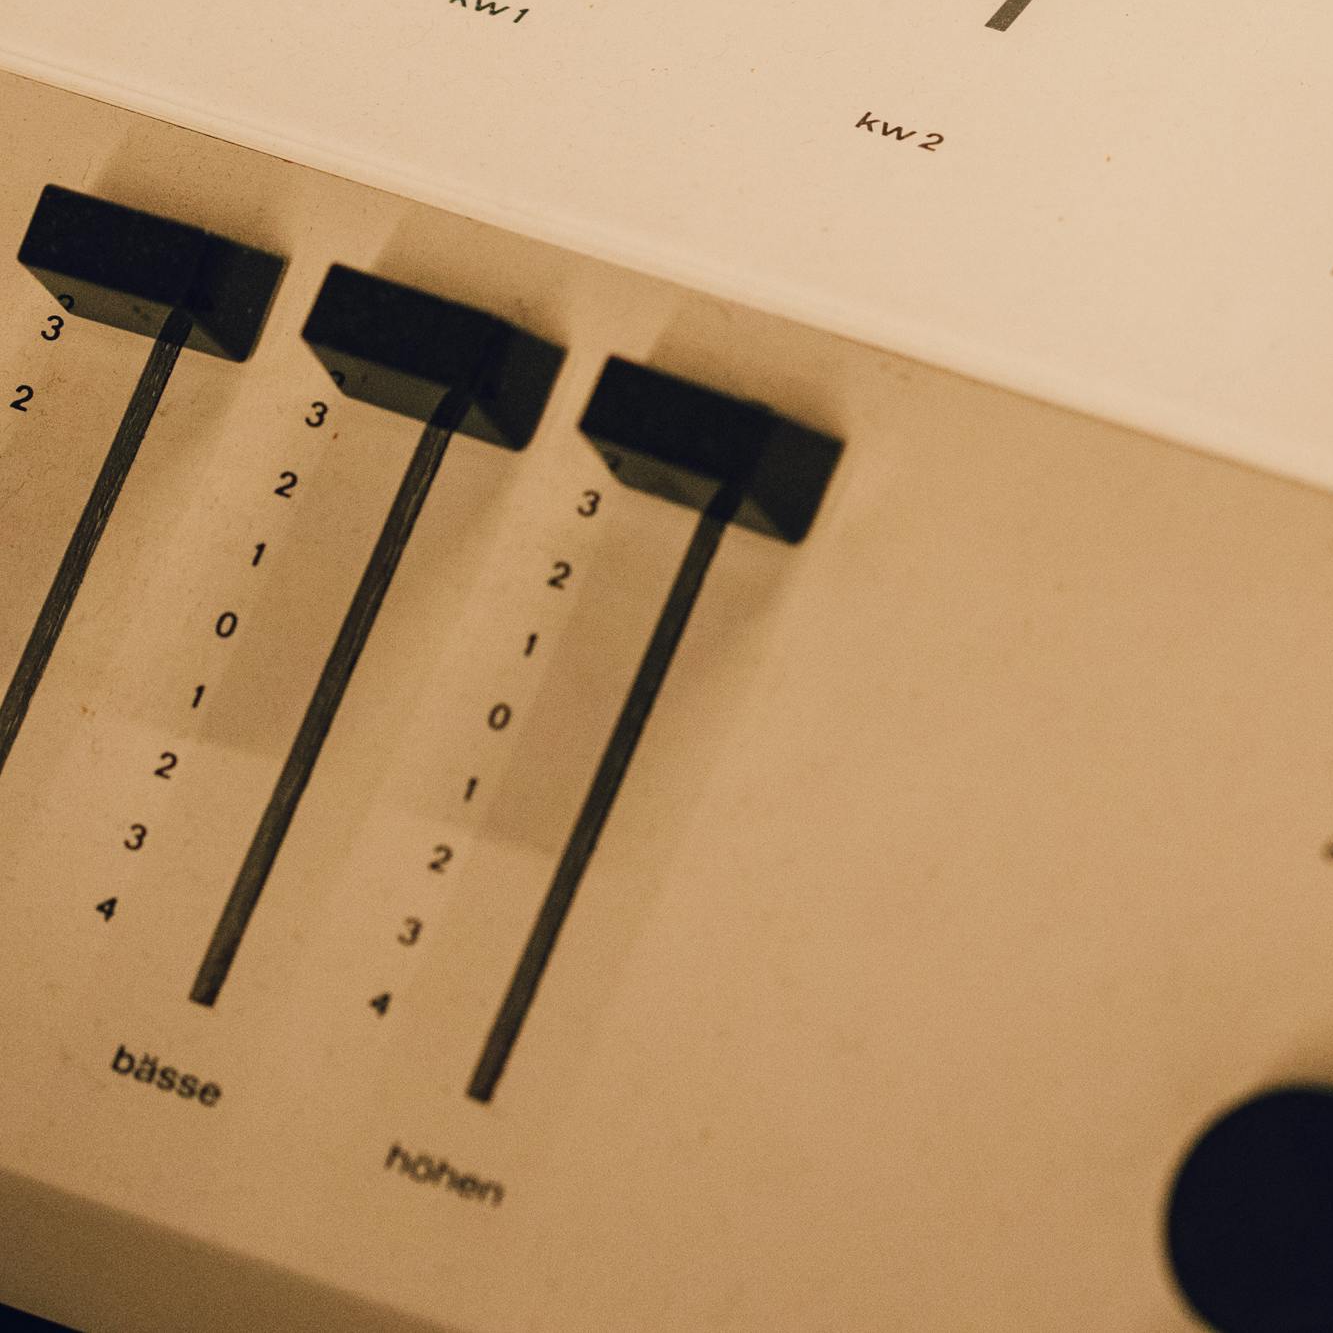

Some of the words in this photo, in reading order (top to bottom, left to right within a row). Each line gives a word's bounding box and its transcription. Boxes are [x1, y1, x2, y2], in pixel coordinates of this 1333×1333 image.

[41, 315, 65, 341] 3
[10, 384, 35, 412] 2
[305, 401, 329, 428] 3
[274, 471, 299, 498] 2
[576, 490, 601, 518] 3
[251, 542, 266, 567] 1
[546, 561, 572, 590] 2
[215, 611, 238, 638] 0
[523, 633, 538, 657] 1
[191, 684, 206, 709] 1
[487, 702, 512, 731] 0
[153, 751, 179, 780] 2
[463, 777, 479, 802] 1
[123, 823, 148, 851] 3
[428, 844, 454, 874] 2
[96, 897, 118, 922] 4
[397, 917, 423, 946] 3
[369, 991, 393, 1017] 4
[109, 1044, 222, 1107] bässe
[384, 1141, 506, 1206] höhen
